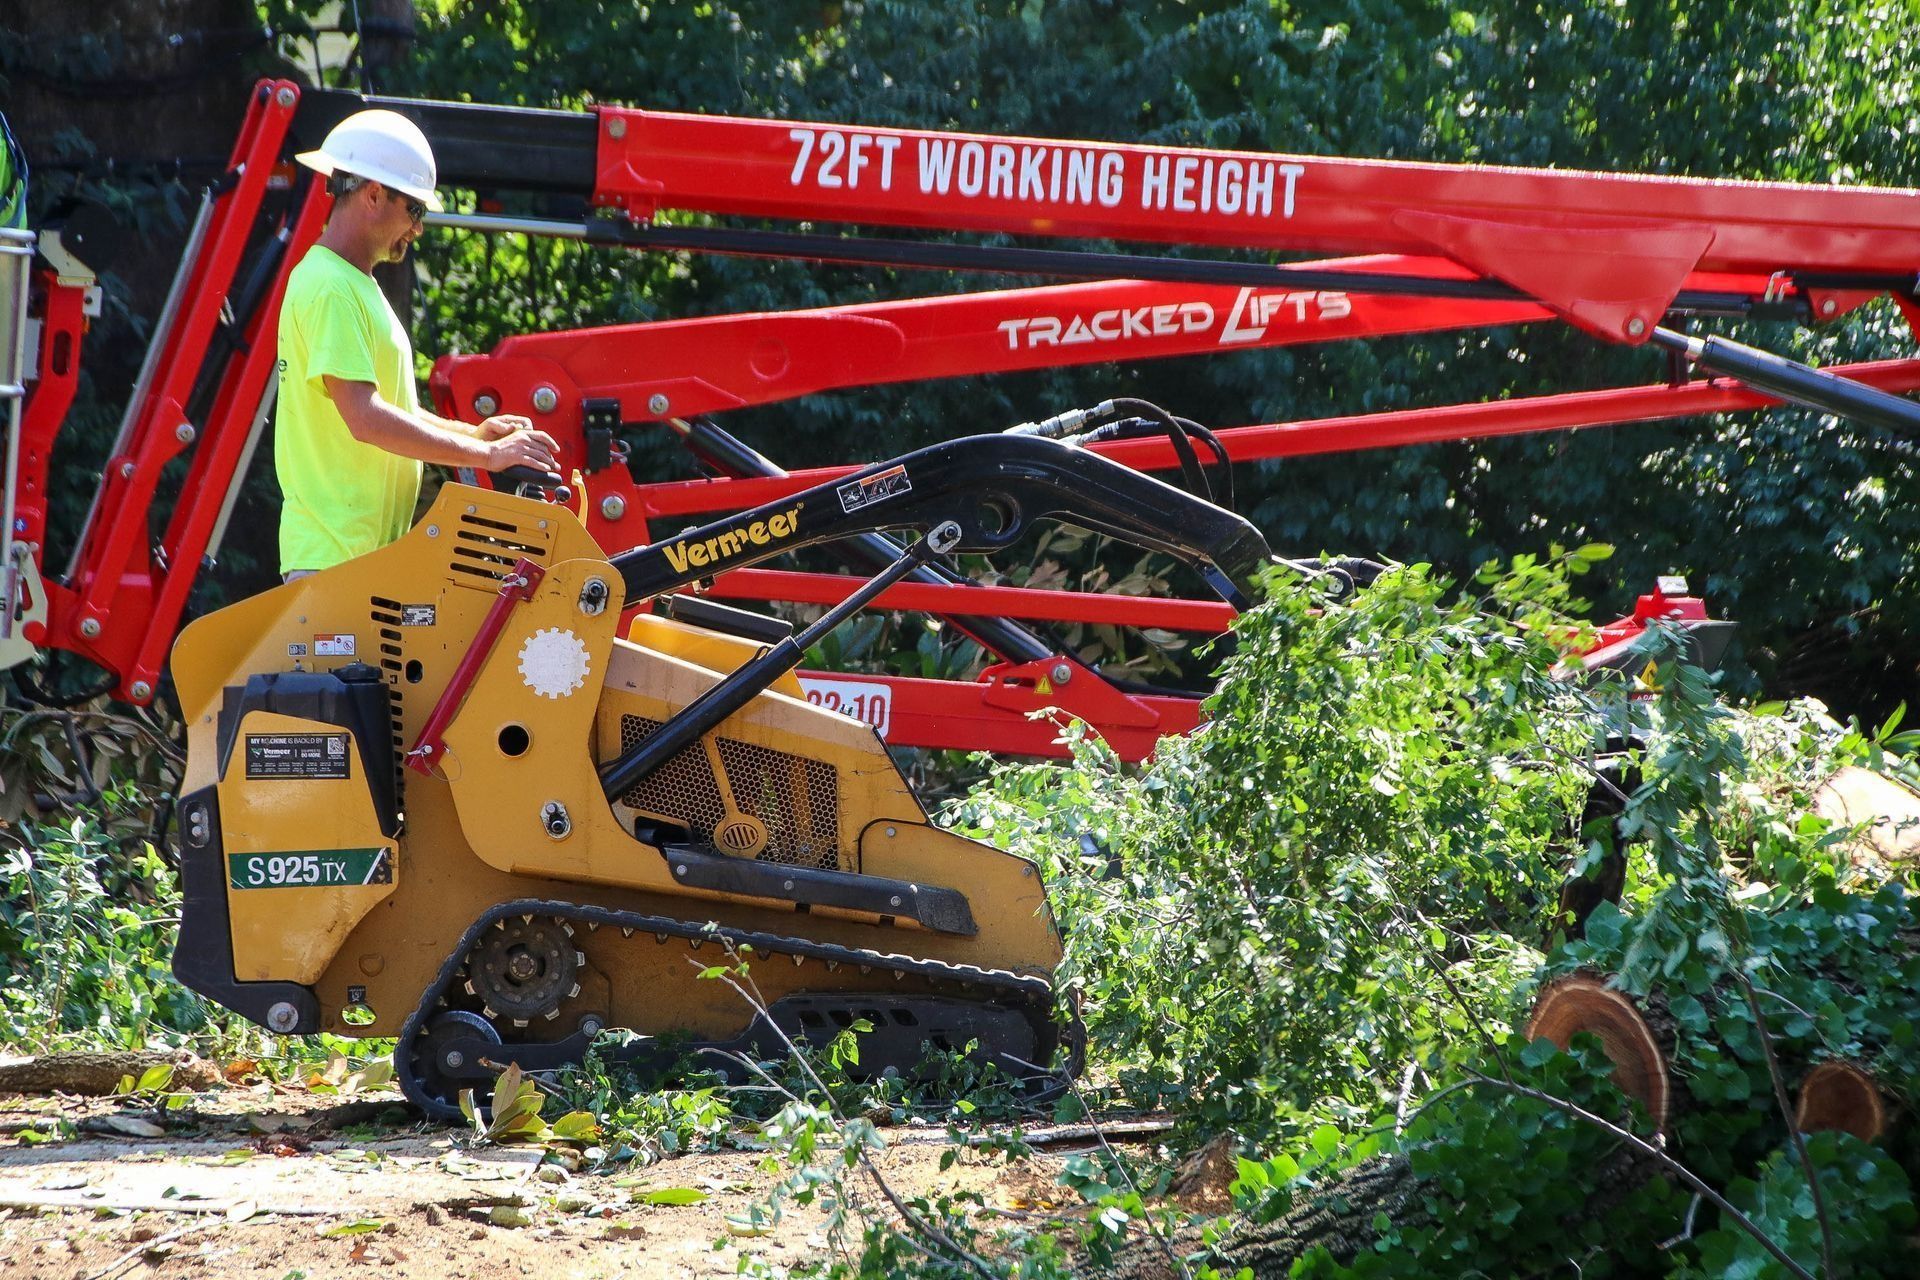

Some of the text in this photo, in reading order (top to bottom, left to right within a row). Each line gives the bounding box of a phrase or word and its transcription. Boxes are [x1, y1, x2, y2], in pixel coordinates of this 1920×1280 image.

[789, 129, 1305, 219] 72FT WORKING HEIGHT
[997, 287, 1353, 350] TRACKED LIFTS
[661, 508, 799, 574] Vermeer
